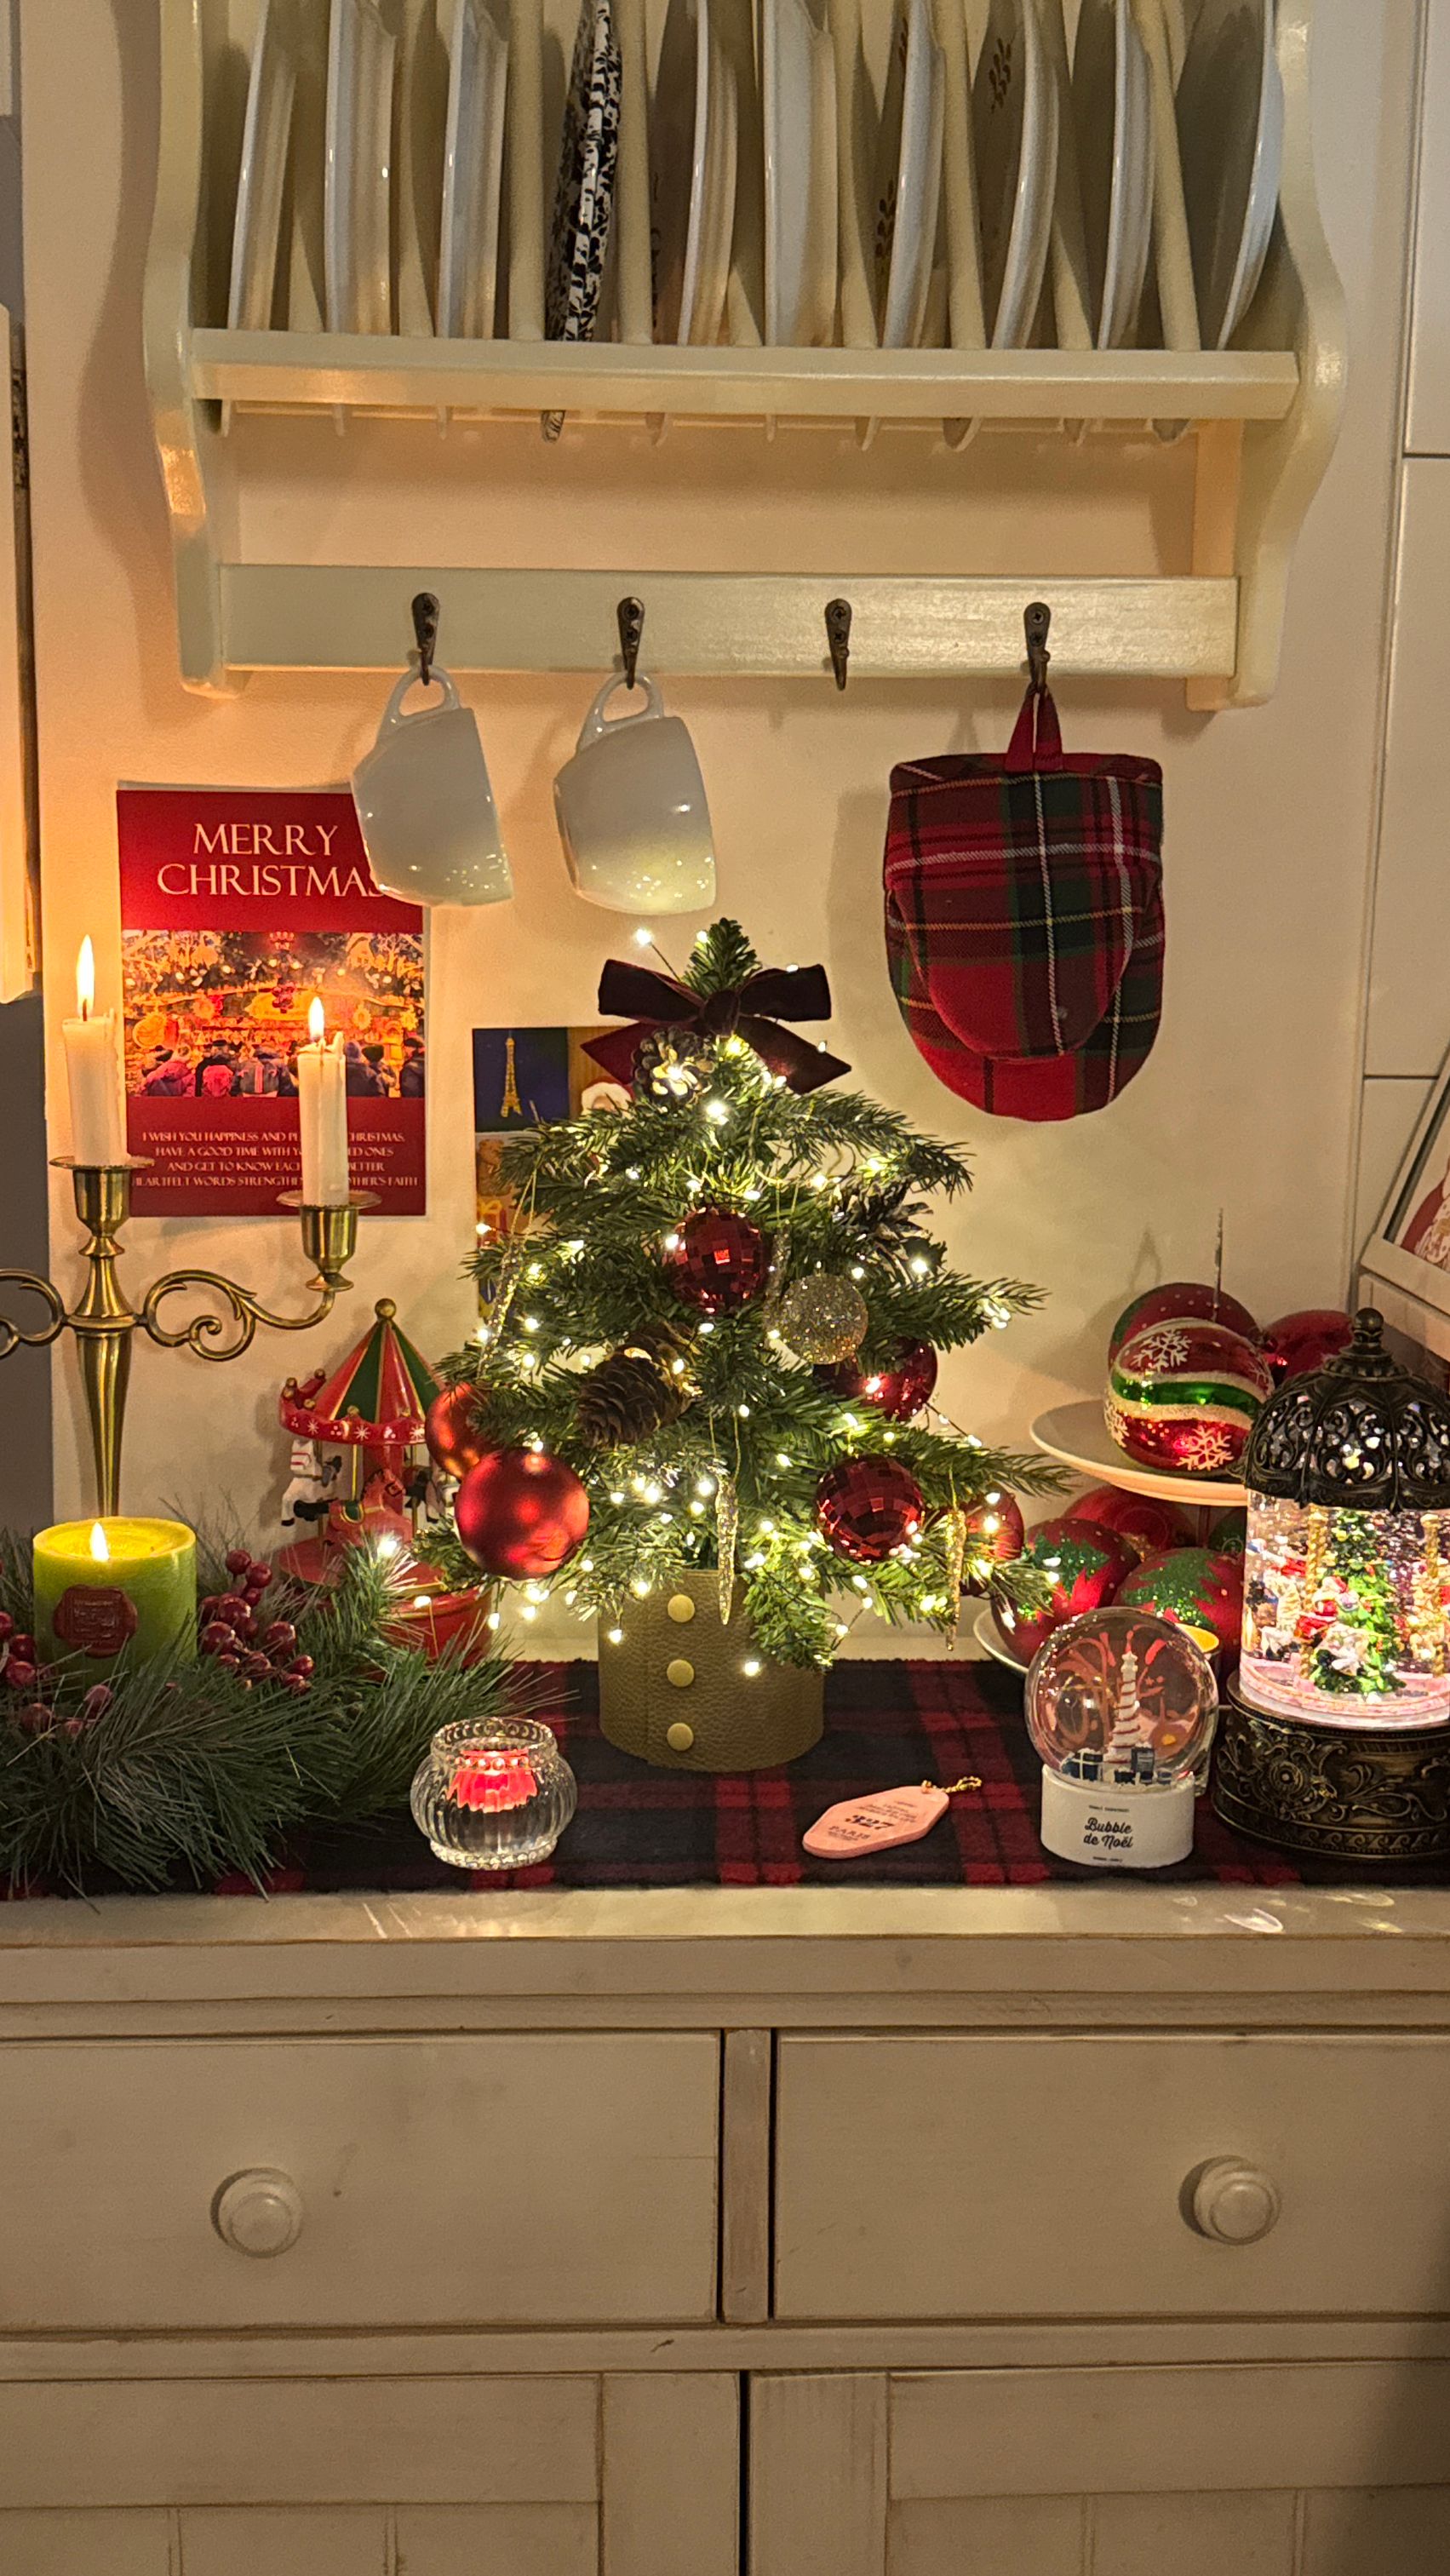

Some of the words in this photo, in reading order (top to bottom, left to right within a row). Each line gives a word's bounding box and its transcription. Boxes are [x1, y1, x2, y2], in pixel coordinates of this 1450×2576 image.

[192, 823, 339, 857] MERRY
[157, 863, 383, 898] CHRISTMA
[148, 1131, 177, 1142] WISH
[179, 1131, 203, 1142] YOU
[204, 1131, 259, 1142] HAPPINESS
[261, 1132, 286, 1142] AND
[155, 1146, 185, 1157] HAVE
[186, 1146, 197, 1157] A
[198, 1146, 234, 1157] GOOD
[235, 1147, 260, 1157] TIME
[261, 1147, 291, 1157] WITH
[364, 1146, 395, 1157] ONES
[167, 1161, 193, 1172] AND
[194, 1162, 215, 1173] GET
[217, 1162, 235, 1173] TO
[236, 1162, 273, 1173] KNOW
[192, 1177, 237, 1187] WORDS
[388, 1177, 419, 1187] FAITH
[844, 1815, 894, 1830] 327
[1084, 1817, 1132, 1833] Bubble
[828, 1826, 871, 1839] PARIS
[1083, 1833, 1099, 1845] de
[1101, 1834, 1133, 1850] Noël
